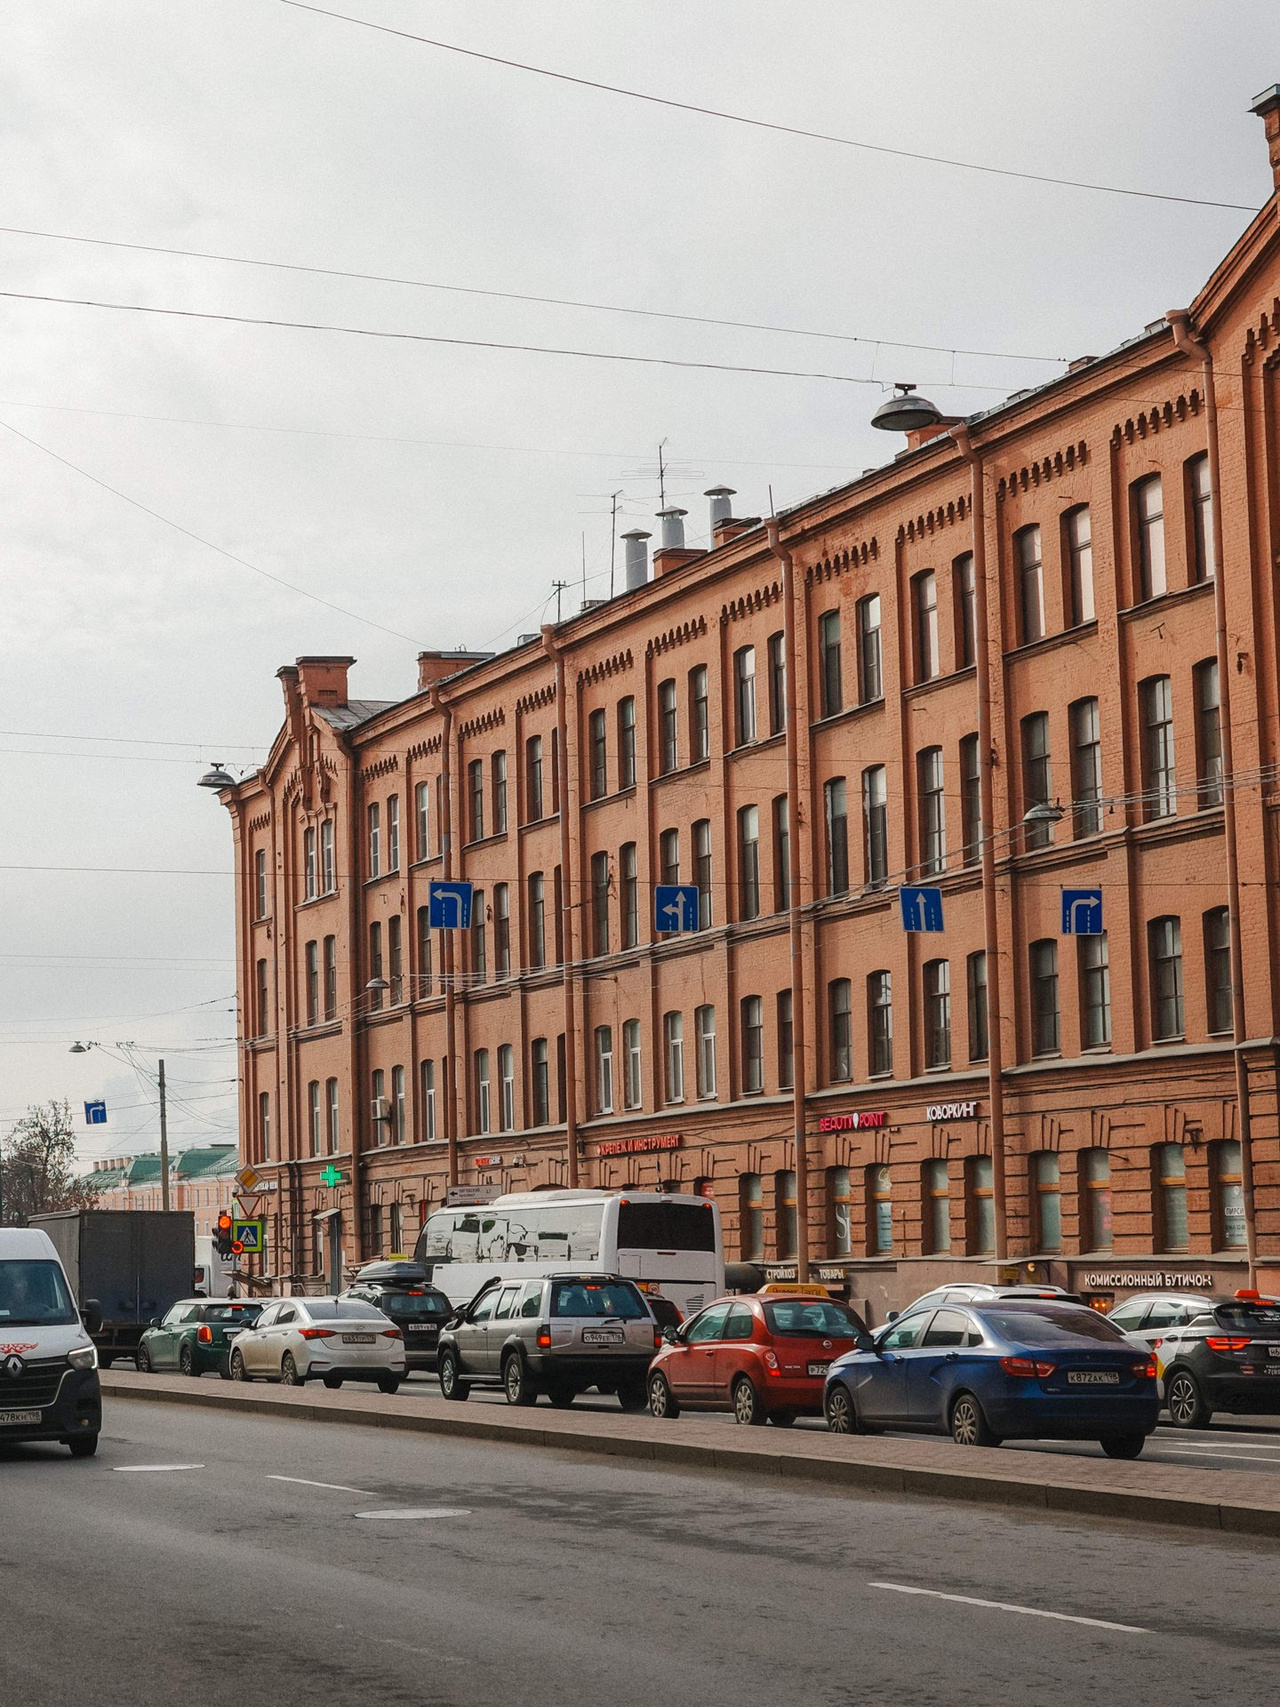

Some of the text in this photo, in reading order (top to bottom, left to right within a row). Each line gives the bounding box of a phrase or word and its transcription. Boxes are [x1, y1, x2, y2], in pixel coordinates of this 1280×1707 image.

[926, 1102, 977, 1121] КОВОРКИНГ
[820, 1112, 884, 1132] BEAUTY POINT
[599, 1134, 680, 1155] КРЕПЕЖ И ИНСТРУМЕНТ
[766, 1266, 845, 1279] СТРОЙХОЗ ТОВАРЫ
[1084, 1273, 1212, 1287] КОМИССИОННЫЙ БУТИЧОК
